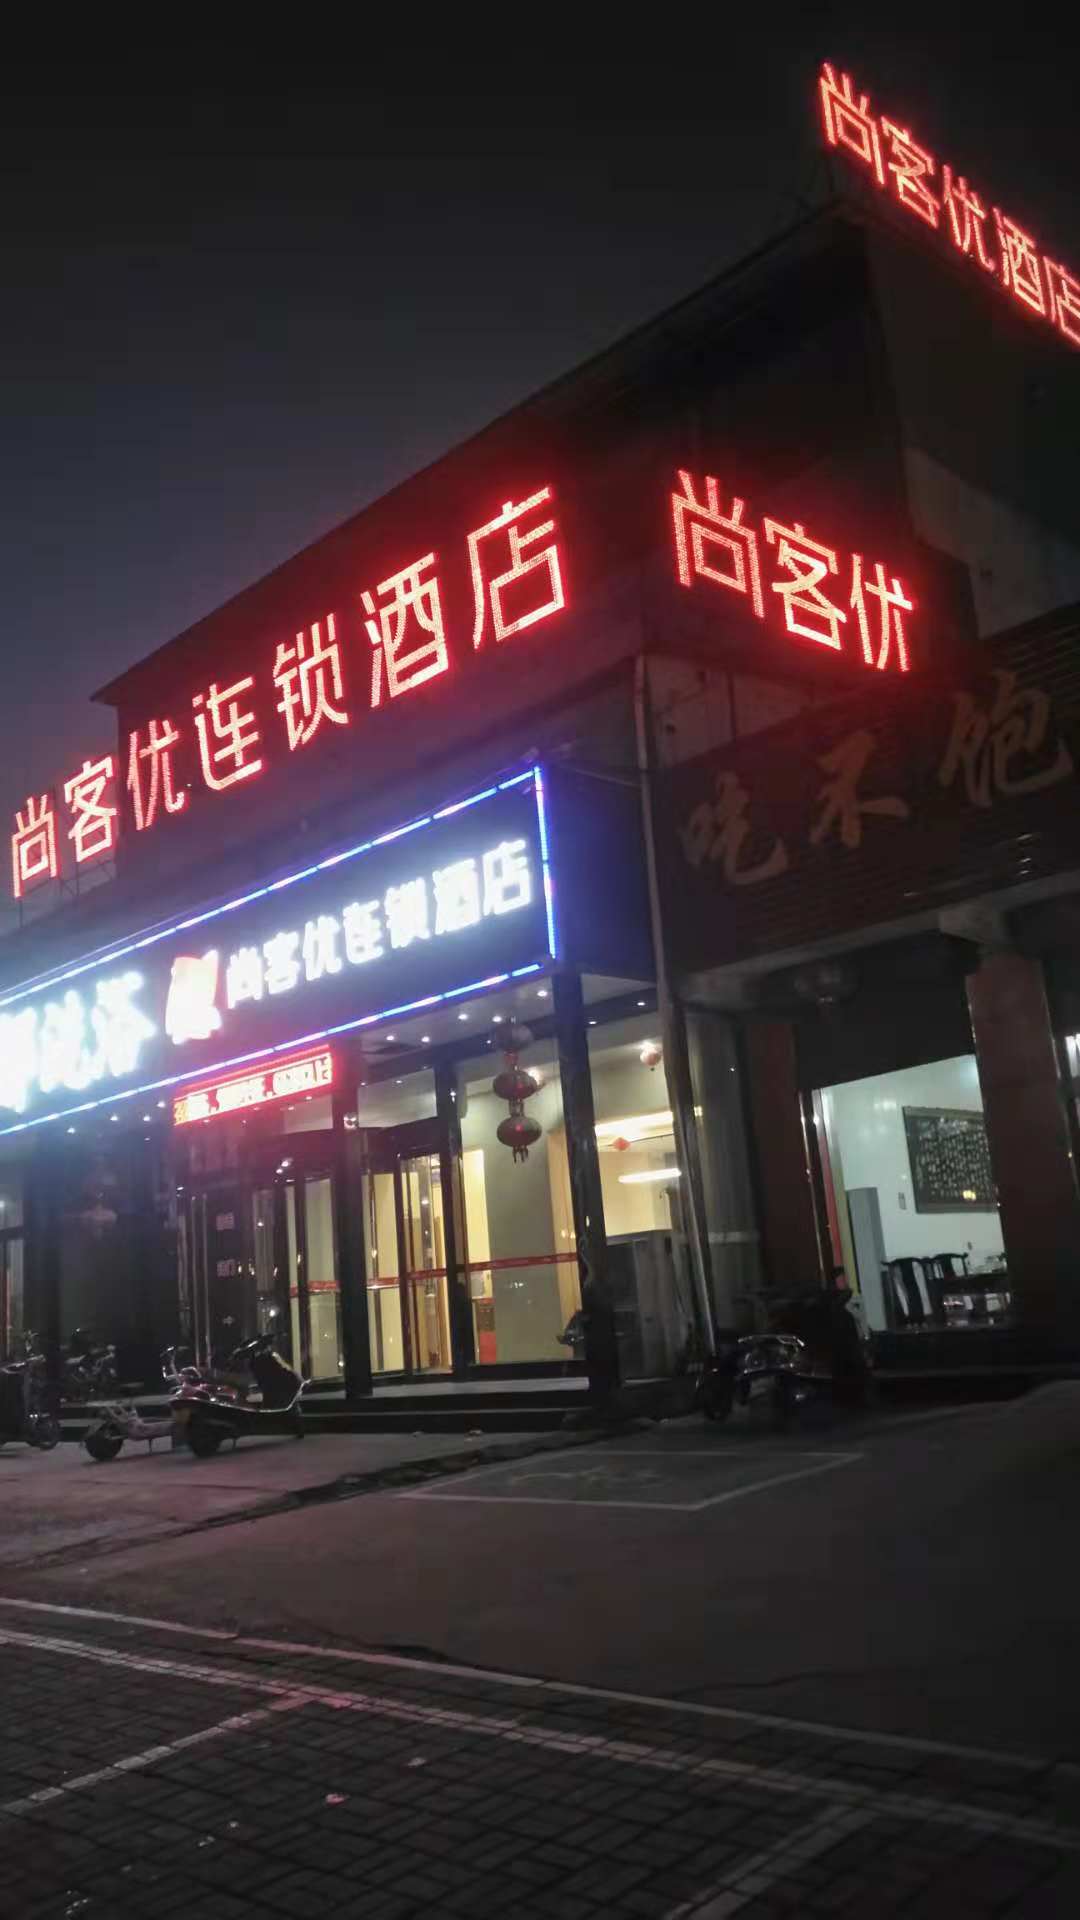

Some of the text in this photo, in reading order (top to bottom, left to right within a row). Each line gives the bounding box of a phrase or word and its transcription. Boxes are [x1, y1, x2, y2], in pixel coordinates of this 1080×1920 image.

[819, 62, 1080, 345] 尚客优酒店
[671, 468, 913, 672] 尚客优
[12, 487, 565, 898] 尚客优连锁酒店
[680, 670, 1075, 886] 吃不饱
[226, 839, 531, 1009] 尚客优连锁酒店
